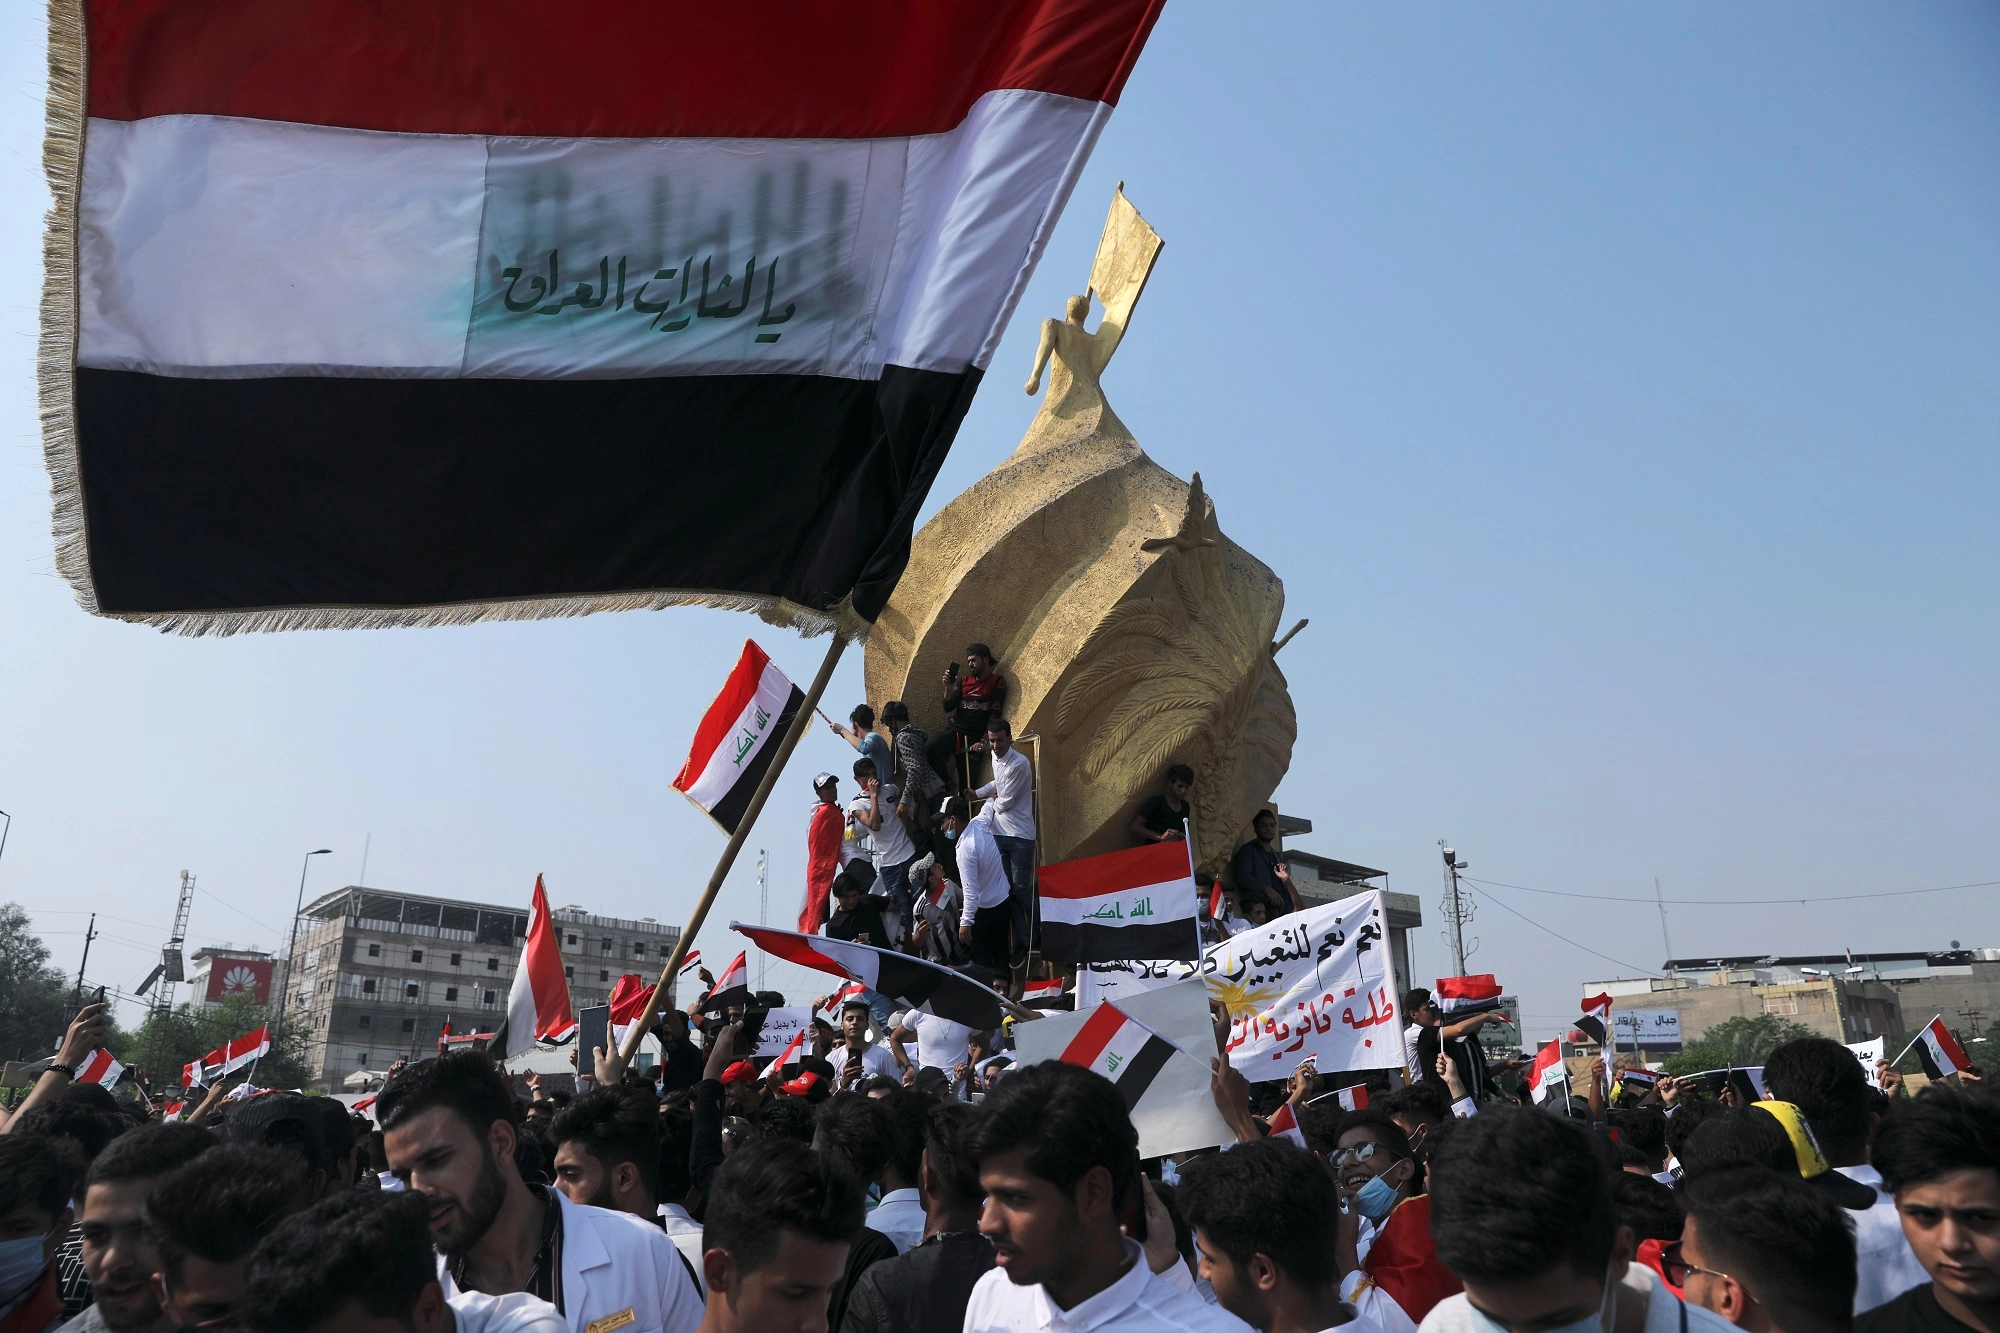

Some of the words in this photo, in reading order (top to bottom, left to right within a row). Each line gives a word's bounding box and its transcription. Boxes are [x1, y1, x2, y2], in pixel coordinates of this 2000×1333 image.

[501, 248, 627, 315] العراق
[754, 705, 772, 732] الله
[1129, 896, 1155, 918] الله
[1219, 922, 1312, 986] للتغيير
[1316, 917, 1346, 991] نعم
[1356, 908, 1383, 986] نعم
[1224, 1013, 1261, 1054] الن
[1265, 992, 1335, 1060] ثانوية
[1341, 985, 1394, 1048] طلبة
[1102, 1051, 1124, 1073] الله
